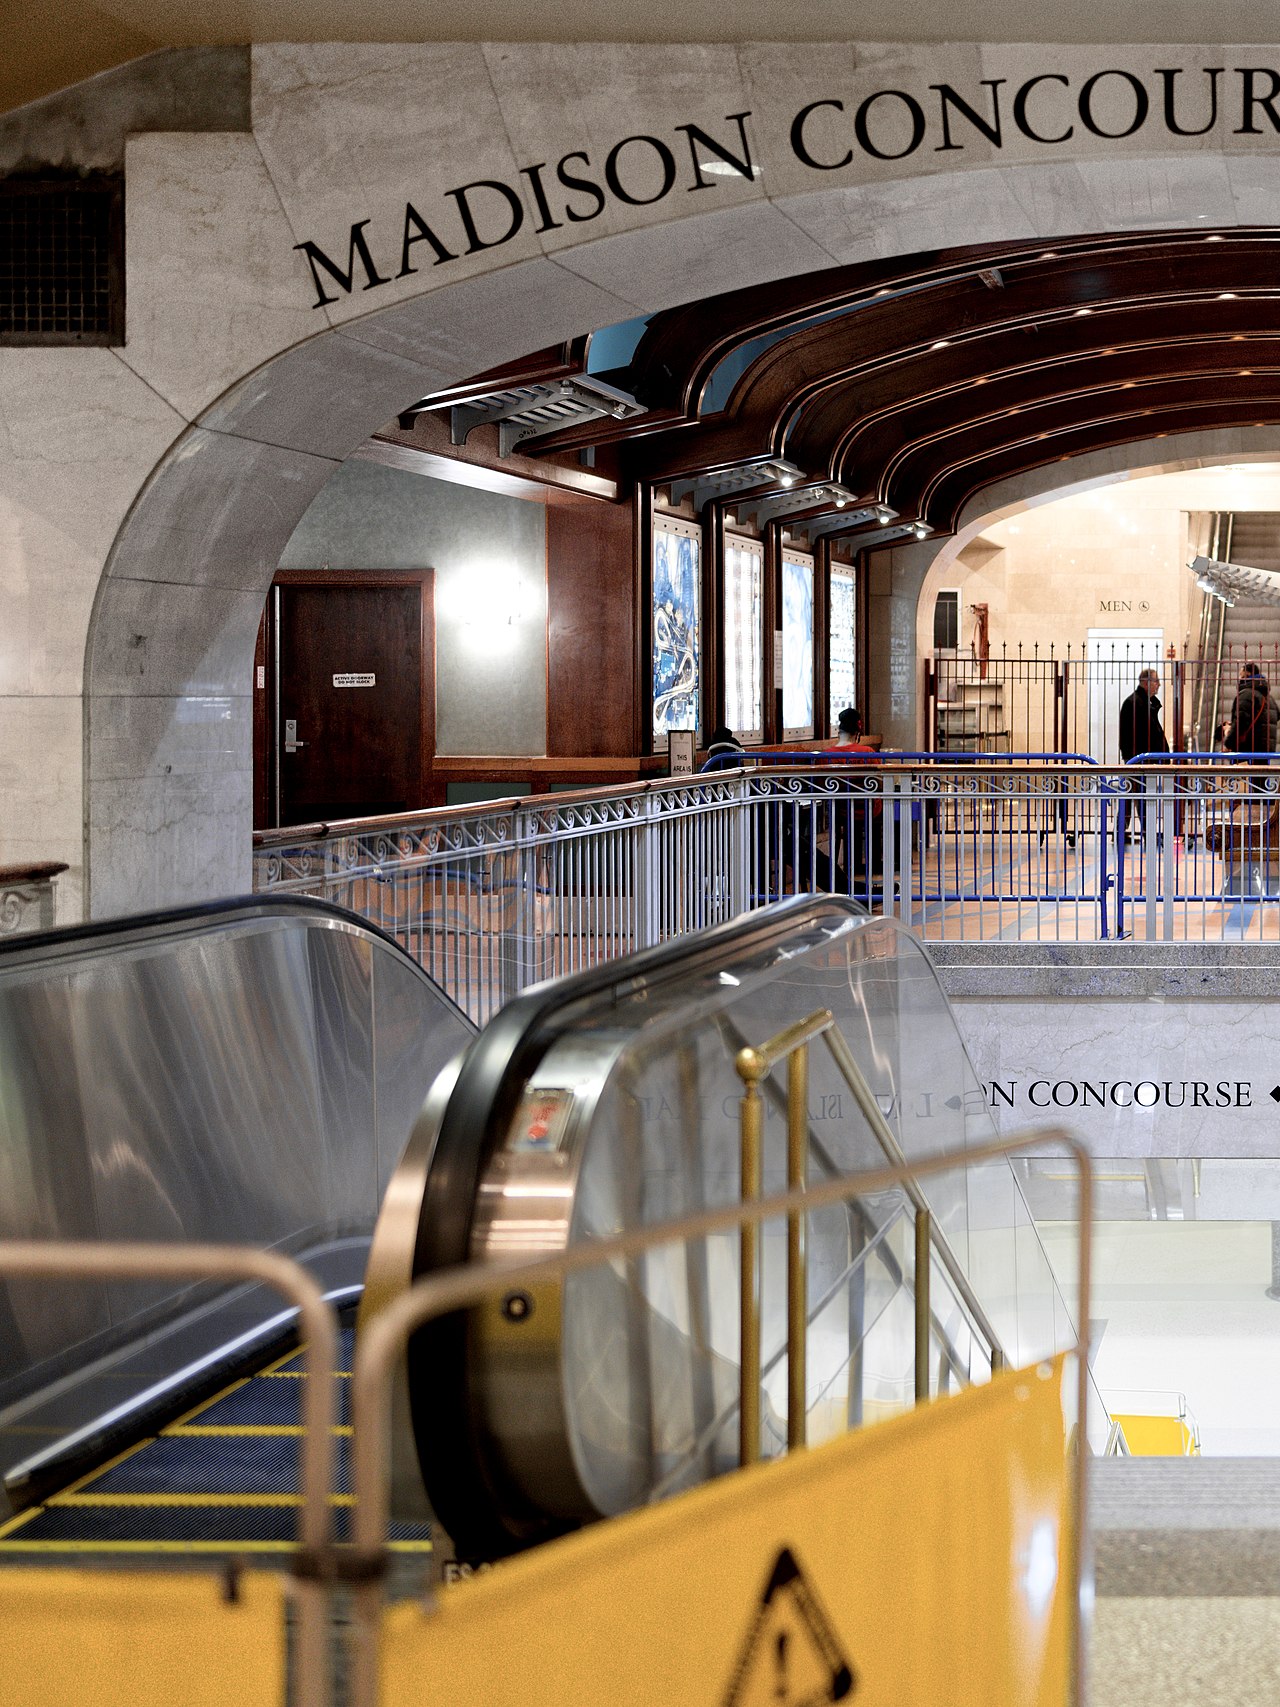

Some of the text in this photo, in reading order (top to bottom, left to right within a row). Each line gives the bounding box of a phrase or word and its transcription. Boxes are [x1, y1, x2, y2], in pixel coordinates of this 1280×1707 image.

[292, 112, 755, 310] MADISON
[1100, 601, 1132, 612] MEN
[981, 1081, 1018, 1108] N
[1028, 1080, 1253, 1108] CONCOURSE
